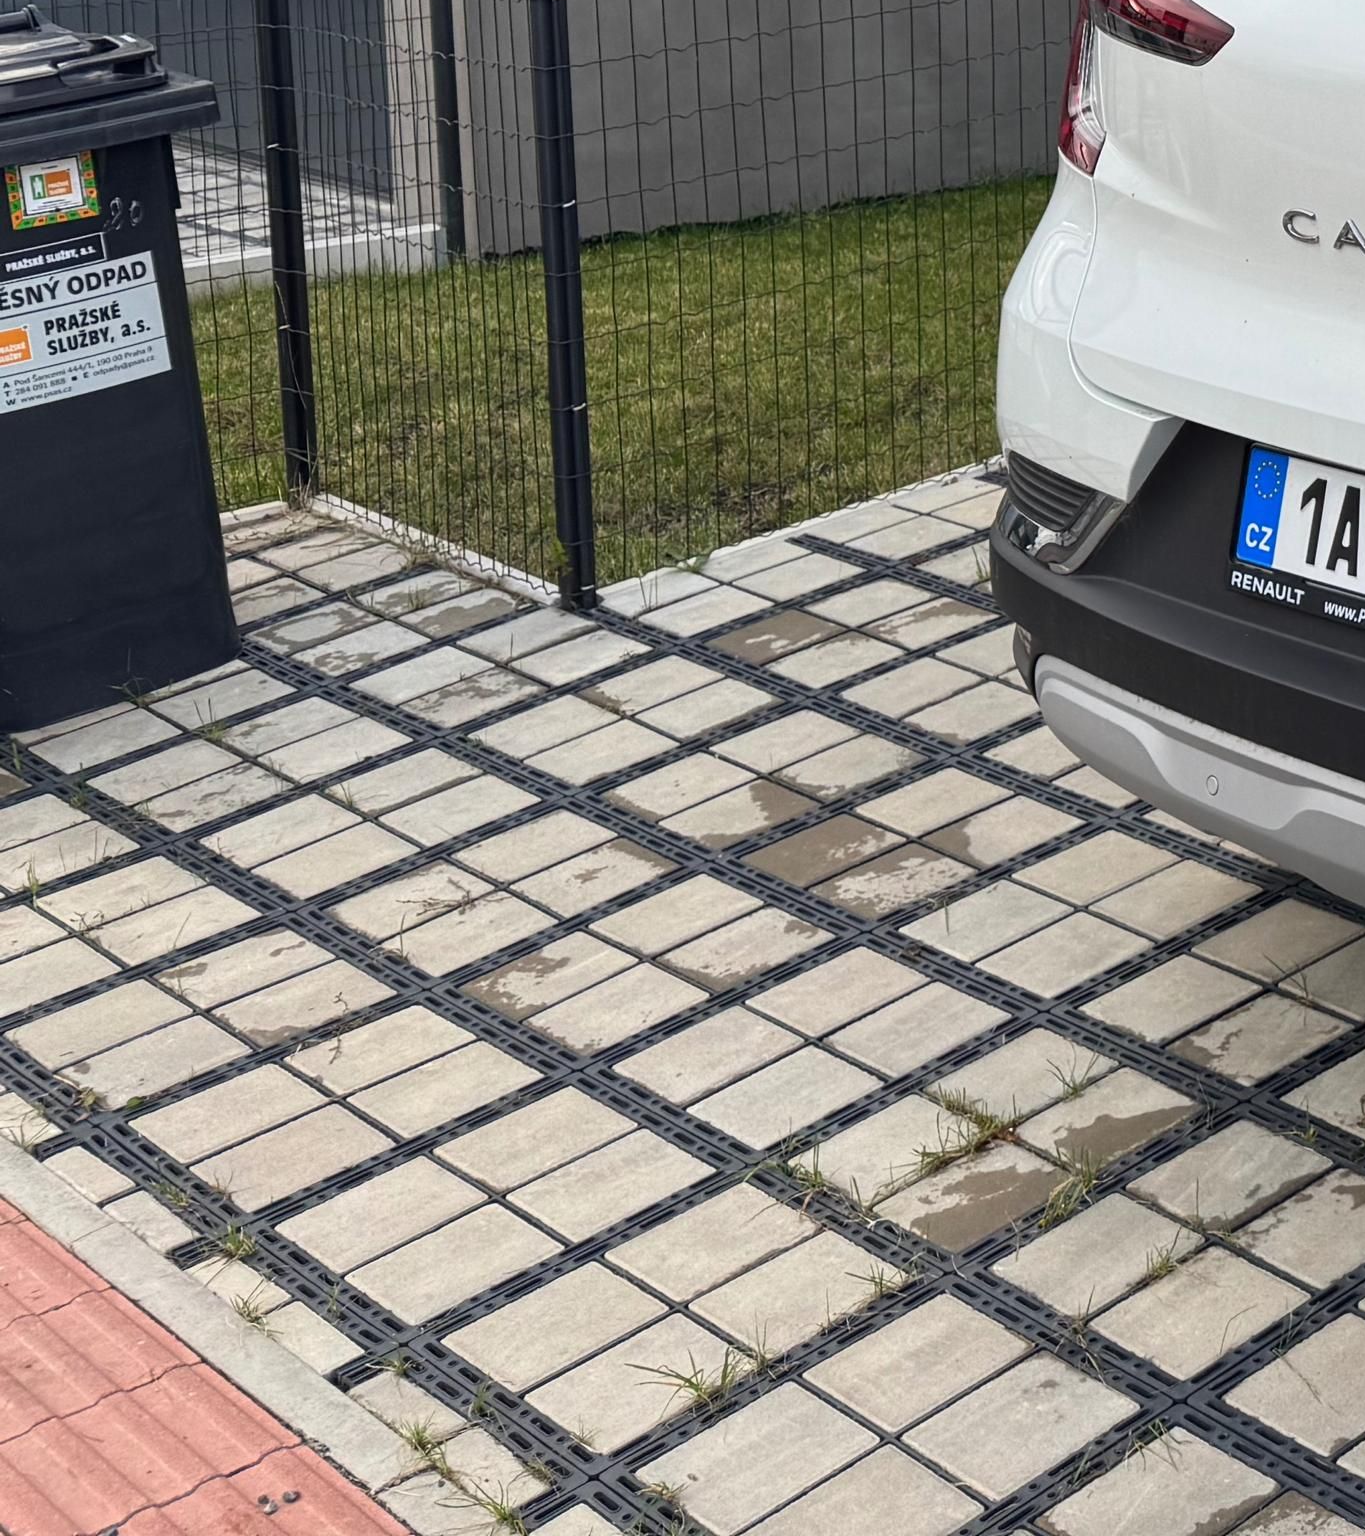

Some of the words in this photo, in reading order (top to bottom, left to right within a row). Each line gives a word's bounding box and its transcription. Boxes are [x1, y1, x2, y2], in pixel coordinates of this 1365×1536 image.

[66, 260, 147, 295] ODPAD
[43, 301, 122, 336] PRAŽSKÉ
[47, 326, 115, 356] SLUŽBY,
[121, 319, 151, 338] a.s.
[14, 376, 31, 386] Pod
[124, 349, 146, 359] Praha
[6, 398, 16, 406] W
[1245, 522, 1273, 552] CZ
[1230, 570, 1306, 607] RENAULT
